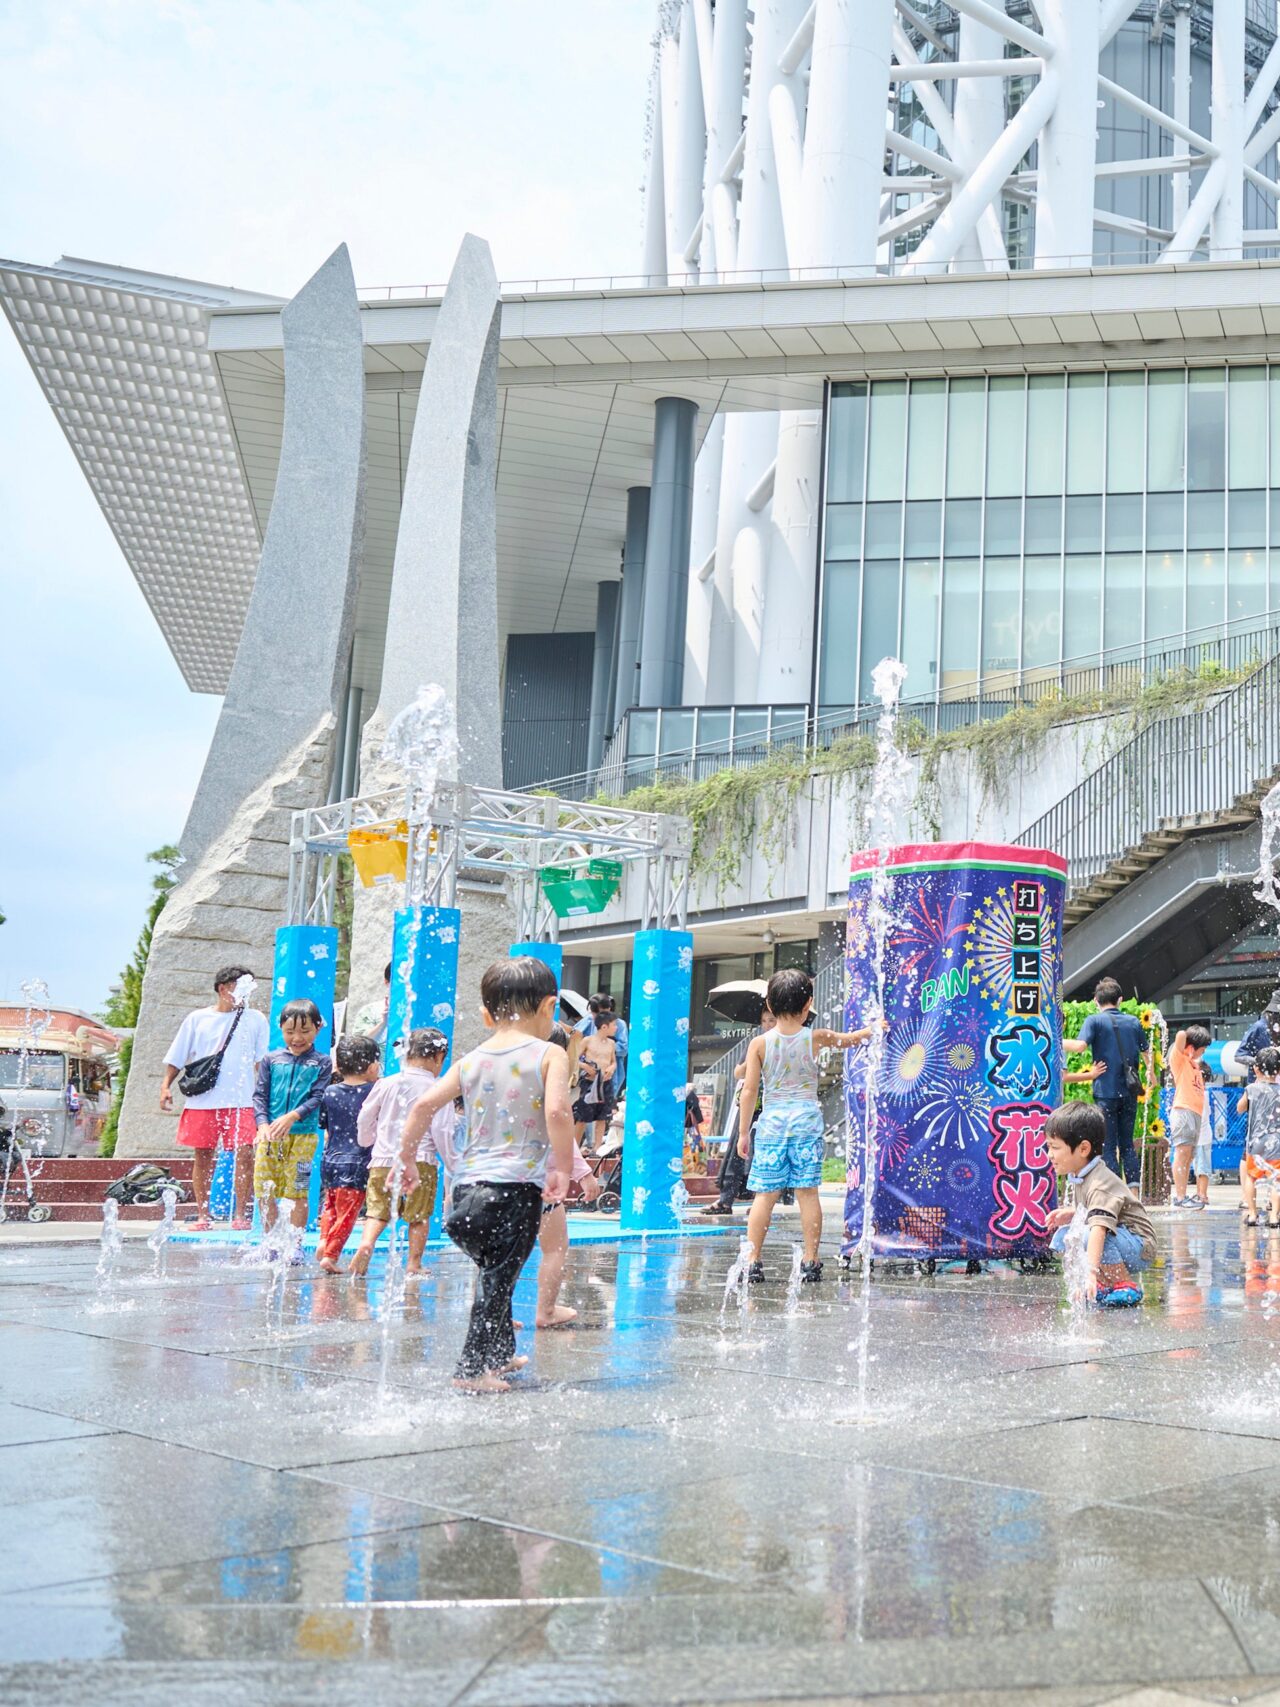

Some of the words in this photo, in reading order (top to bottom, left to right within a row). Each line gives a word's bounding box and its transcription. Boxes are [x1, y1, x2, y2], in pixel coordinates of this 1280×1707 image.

[921, 963, 969, 1013] BAN
[1016, 887, 1038, 1010] 打ち上げ
